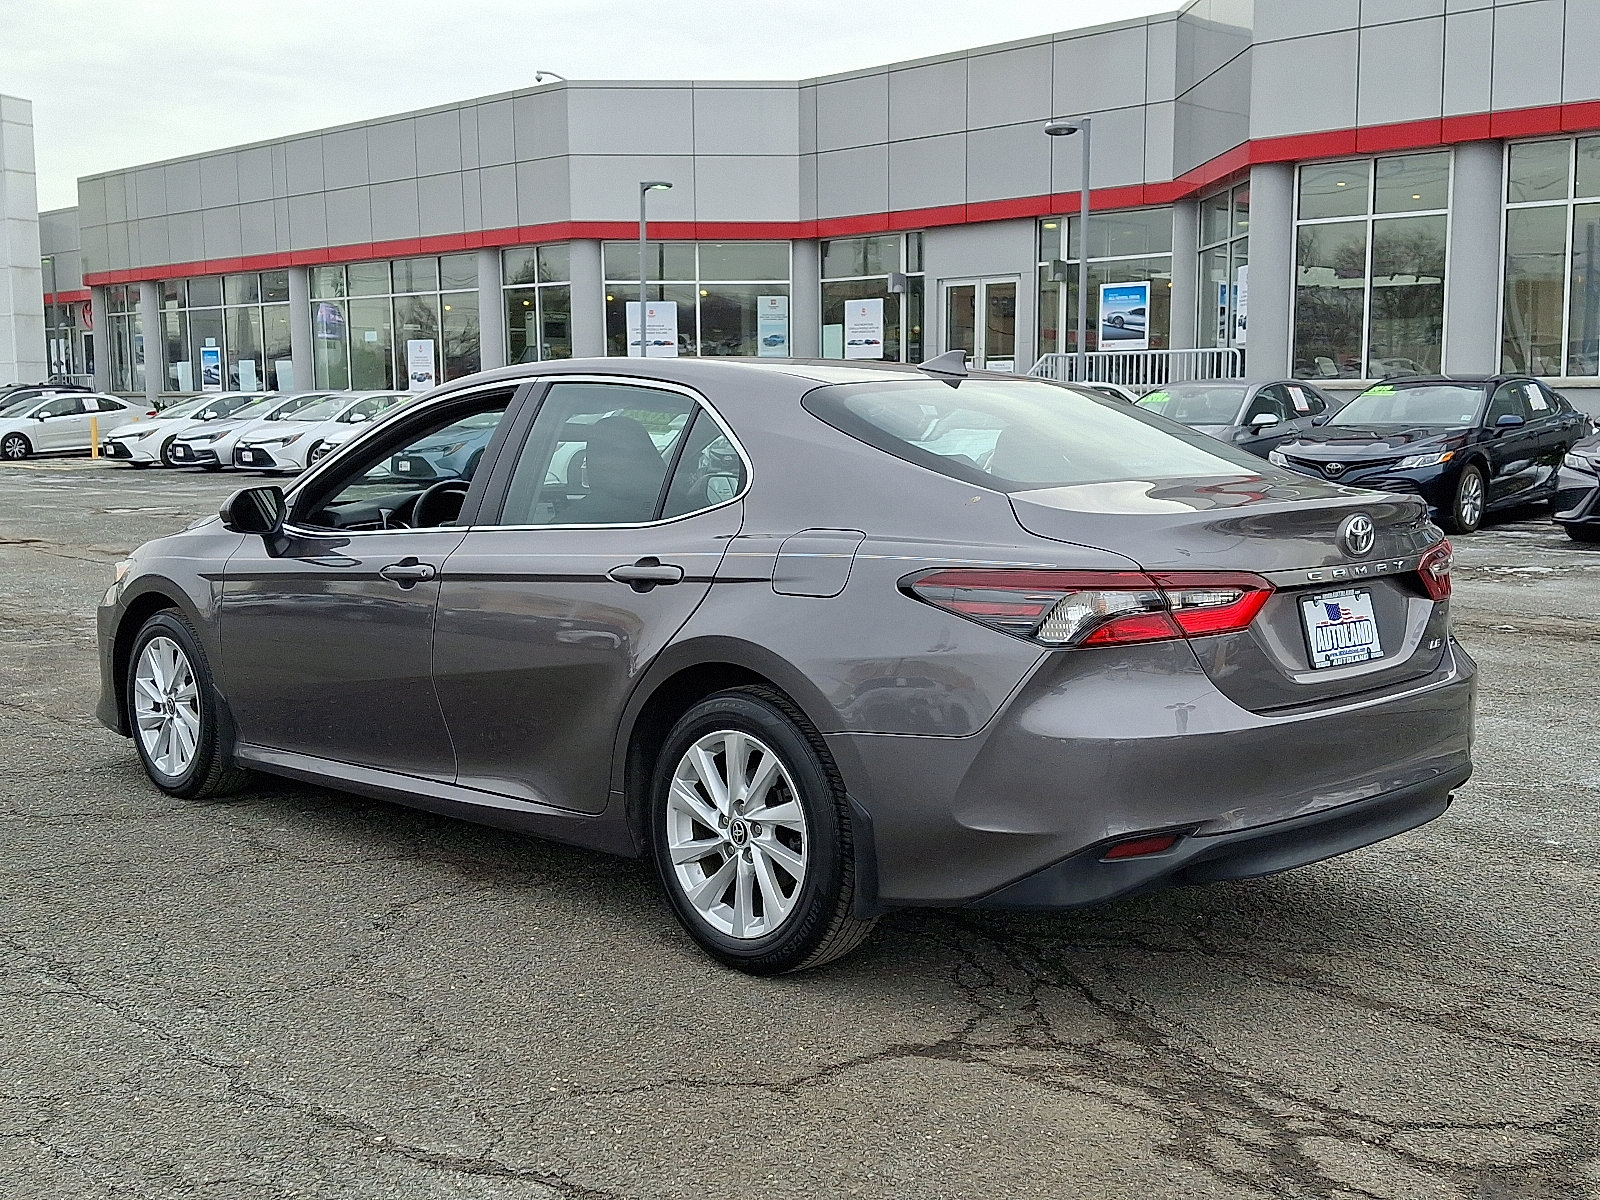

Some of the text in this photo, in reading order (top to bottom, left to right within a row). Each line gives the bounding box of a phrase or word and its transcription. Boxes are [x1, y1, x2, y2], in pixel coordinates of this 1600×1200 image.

[1307, 560, 1403, 580] CAMRY
[1316, 620, 1373, 652] AUTOLAND
[1428, 638, 1441, 650] LE
[1332, 653, 1369, 666] AUTOLAND
